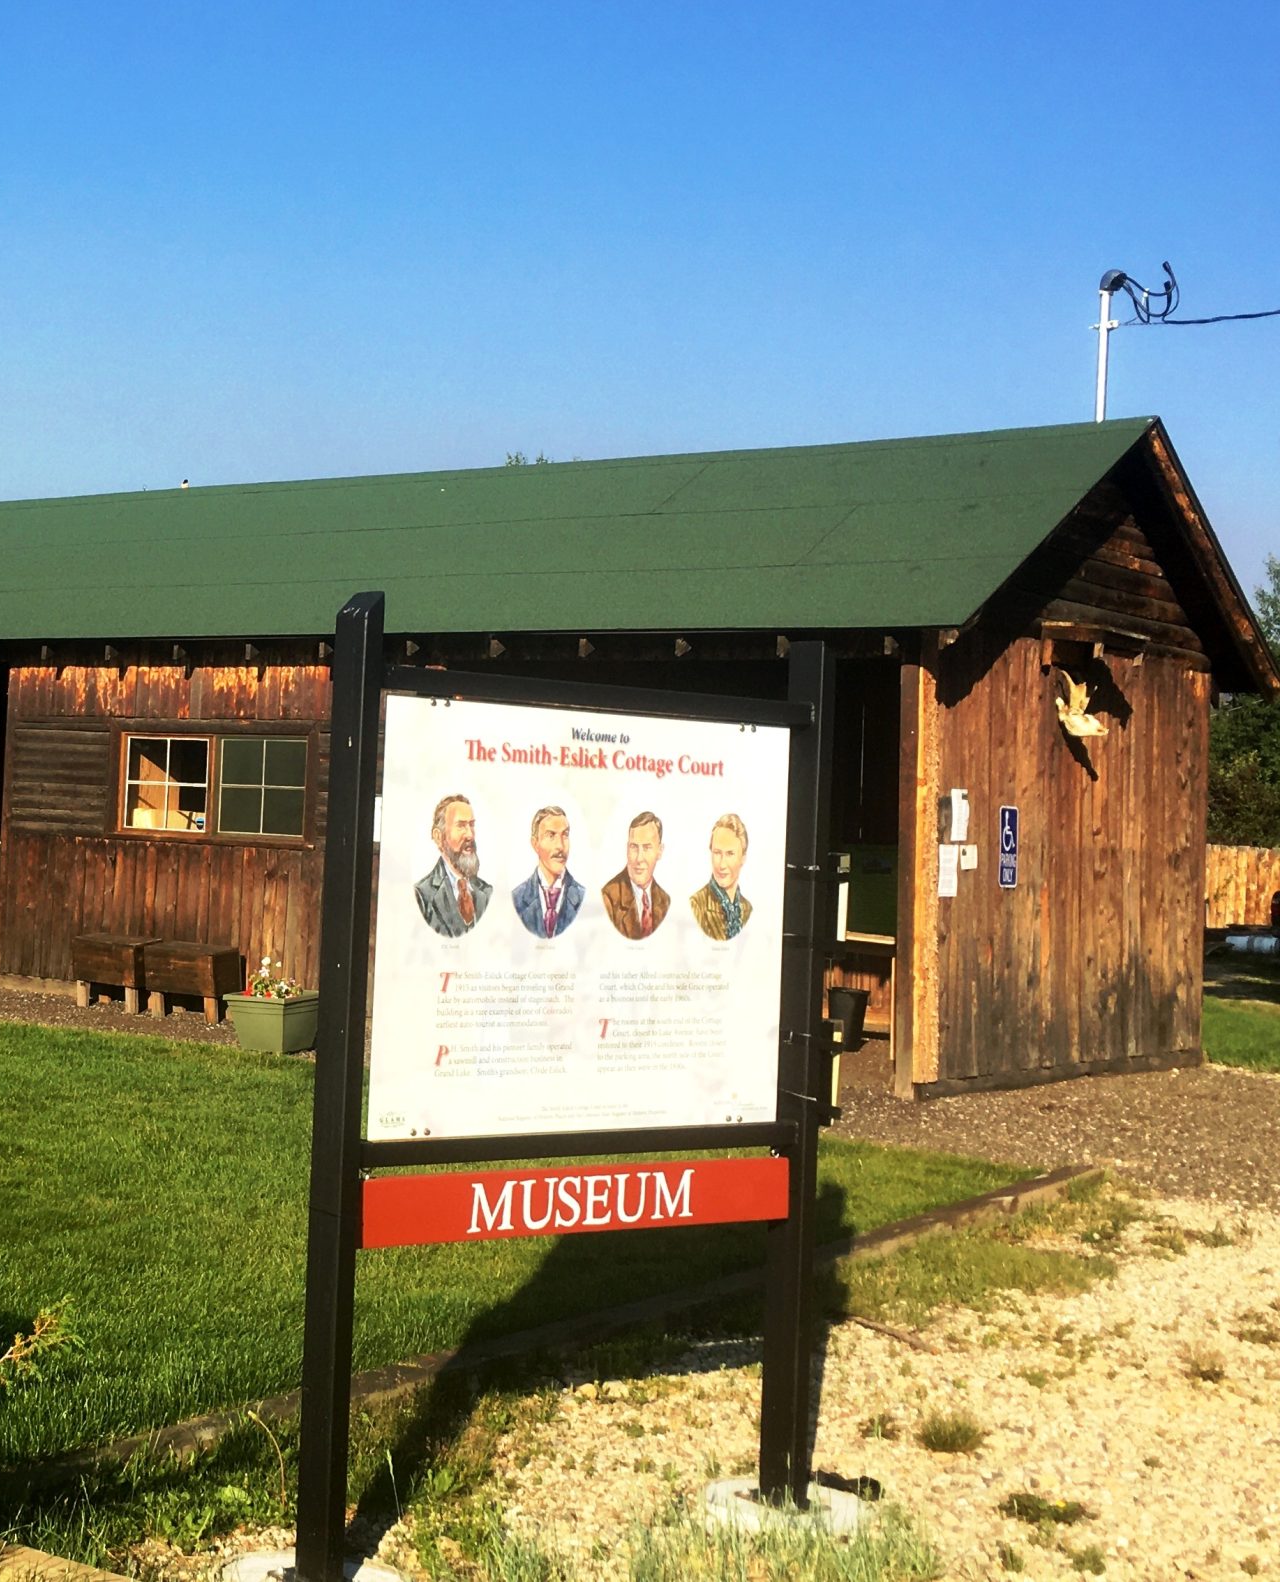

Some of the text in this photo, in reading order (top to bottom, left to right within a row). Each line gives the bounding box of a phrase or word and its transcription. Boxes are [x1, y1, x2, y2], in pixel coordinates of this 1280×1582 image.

[571, 727, 631, 745] Welcome to
[465, 738, 724, 778] The Smith-Eslick Cottage Court
[1001, 853, 1017, 867] PARKING
[1002, 868, 1014, 882] ONLY
[504, 971, 527, 982] Cottage
[528, 971, 546, 980] Court
[547, 971, 569, 981] opened
[502, 984, 520, 993] began
[555, 983, 575, 991] Grand
[437, 1008, 463, 1018] building
[489, 1008, 514, 1017] example
[480, 1044, 491, 1052] and
[547, 1041, 572, 1053] operated
[479, 1056, 490, 1064] and
[466, 1168, 695, 1235] MUSEUM
